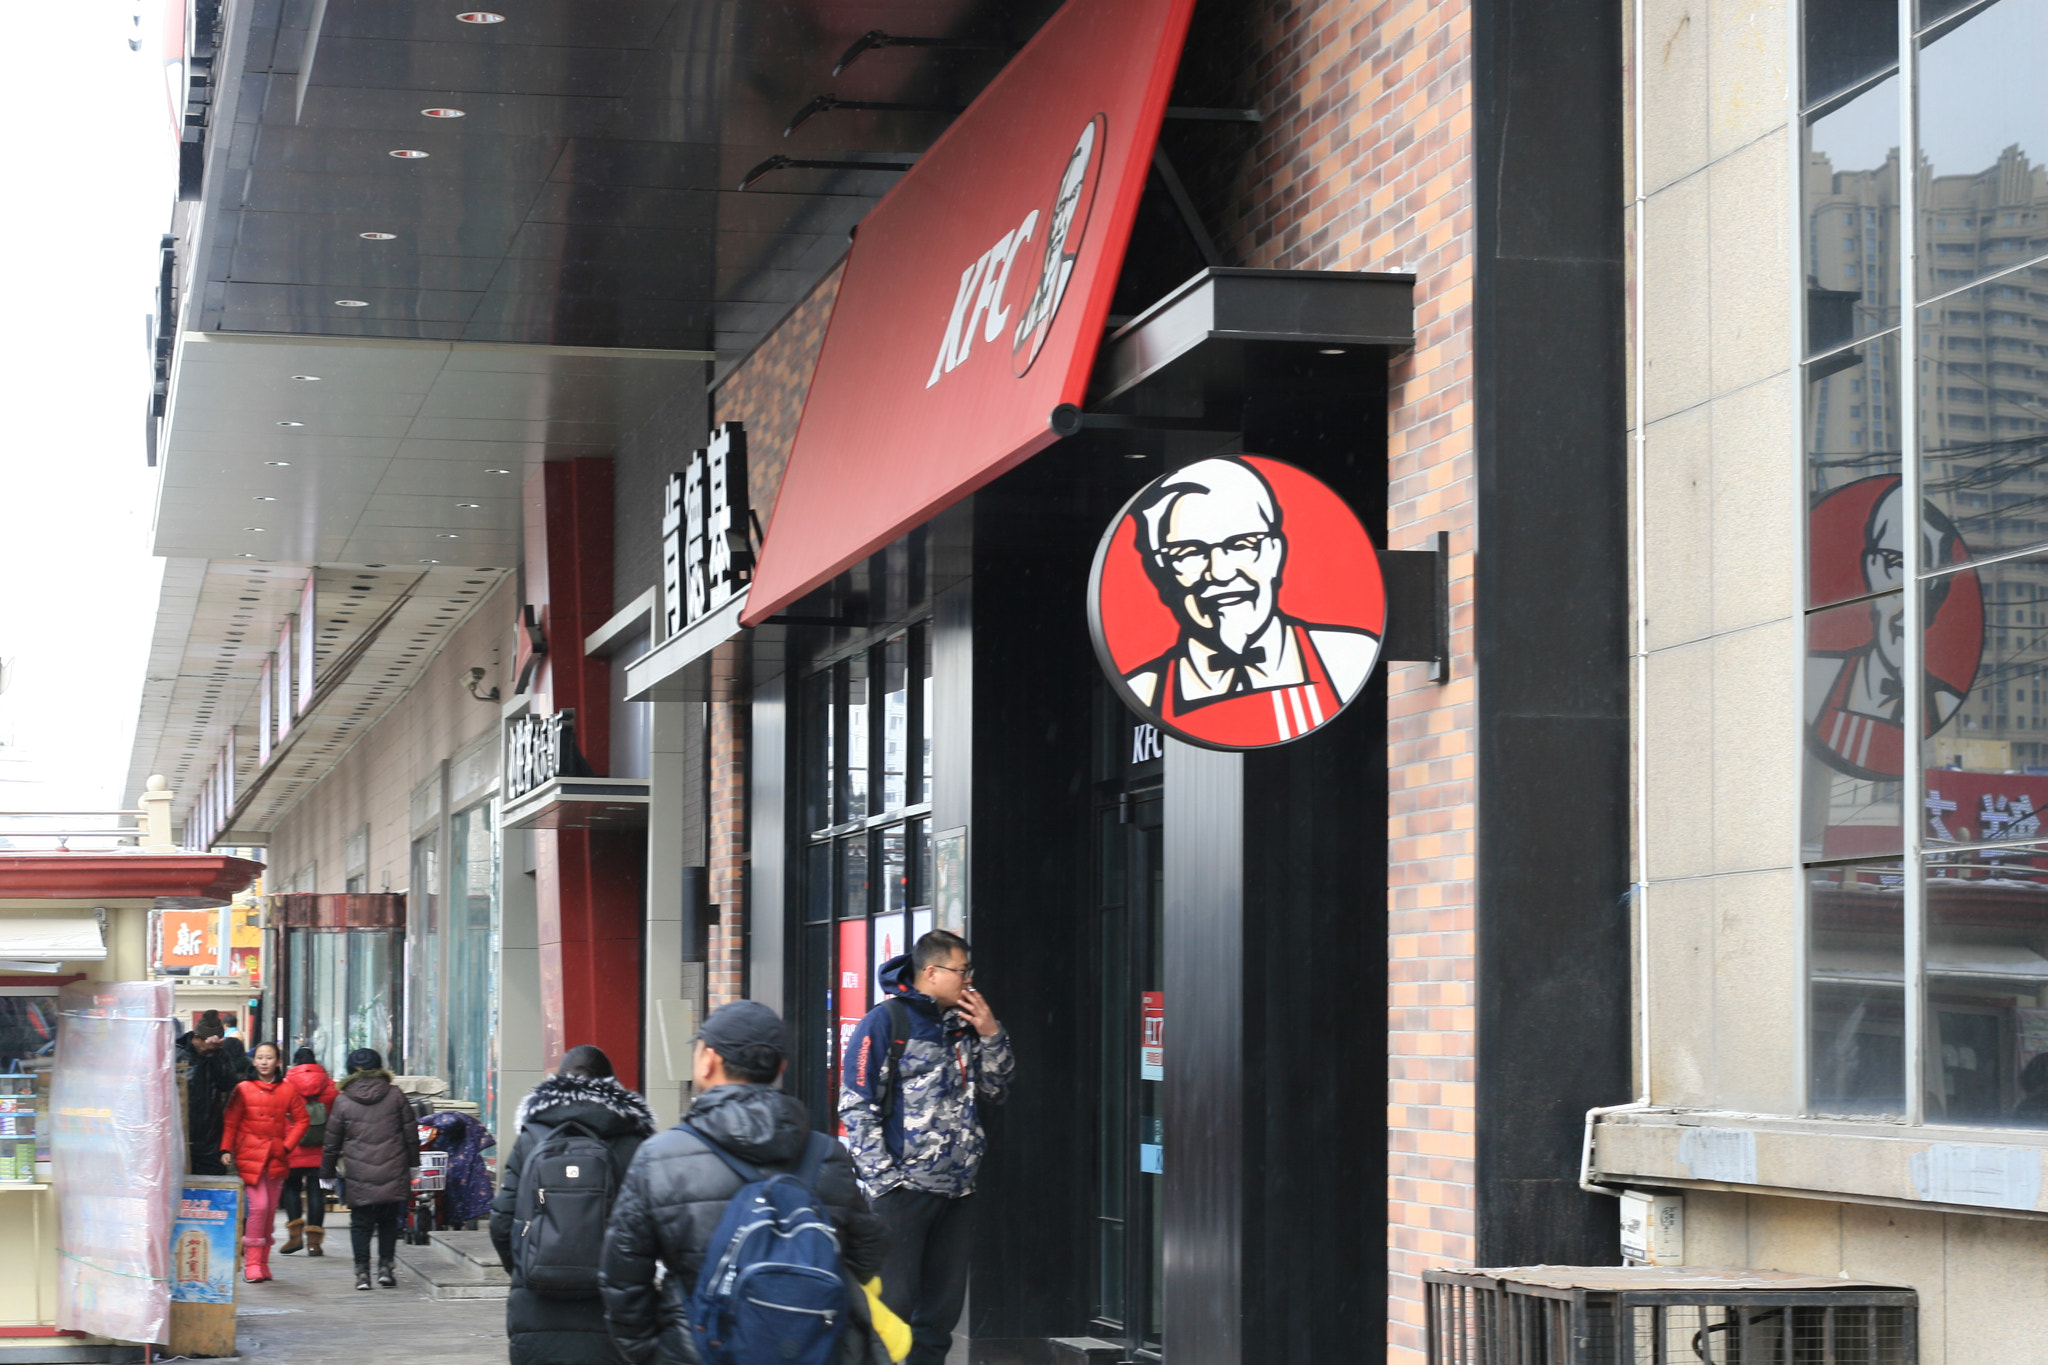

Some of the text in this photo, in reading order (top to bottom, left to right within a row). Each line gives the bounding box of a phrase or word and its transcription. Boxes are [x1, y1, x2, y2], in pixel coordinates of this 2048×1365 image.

[925, 209, 1040, 389] KFC
[662, 422, 731, 640] 肯德基
[1132, 723, 1163, 764] KFC
